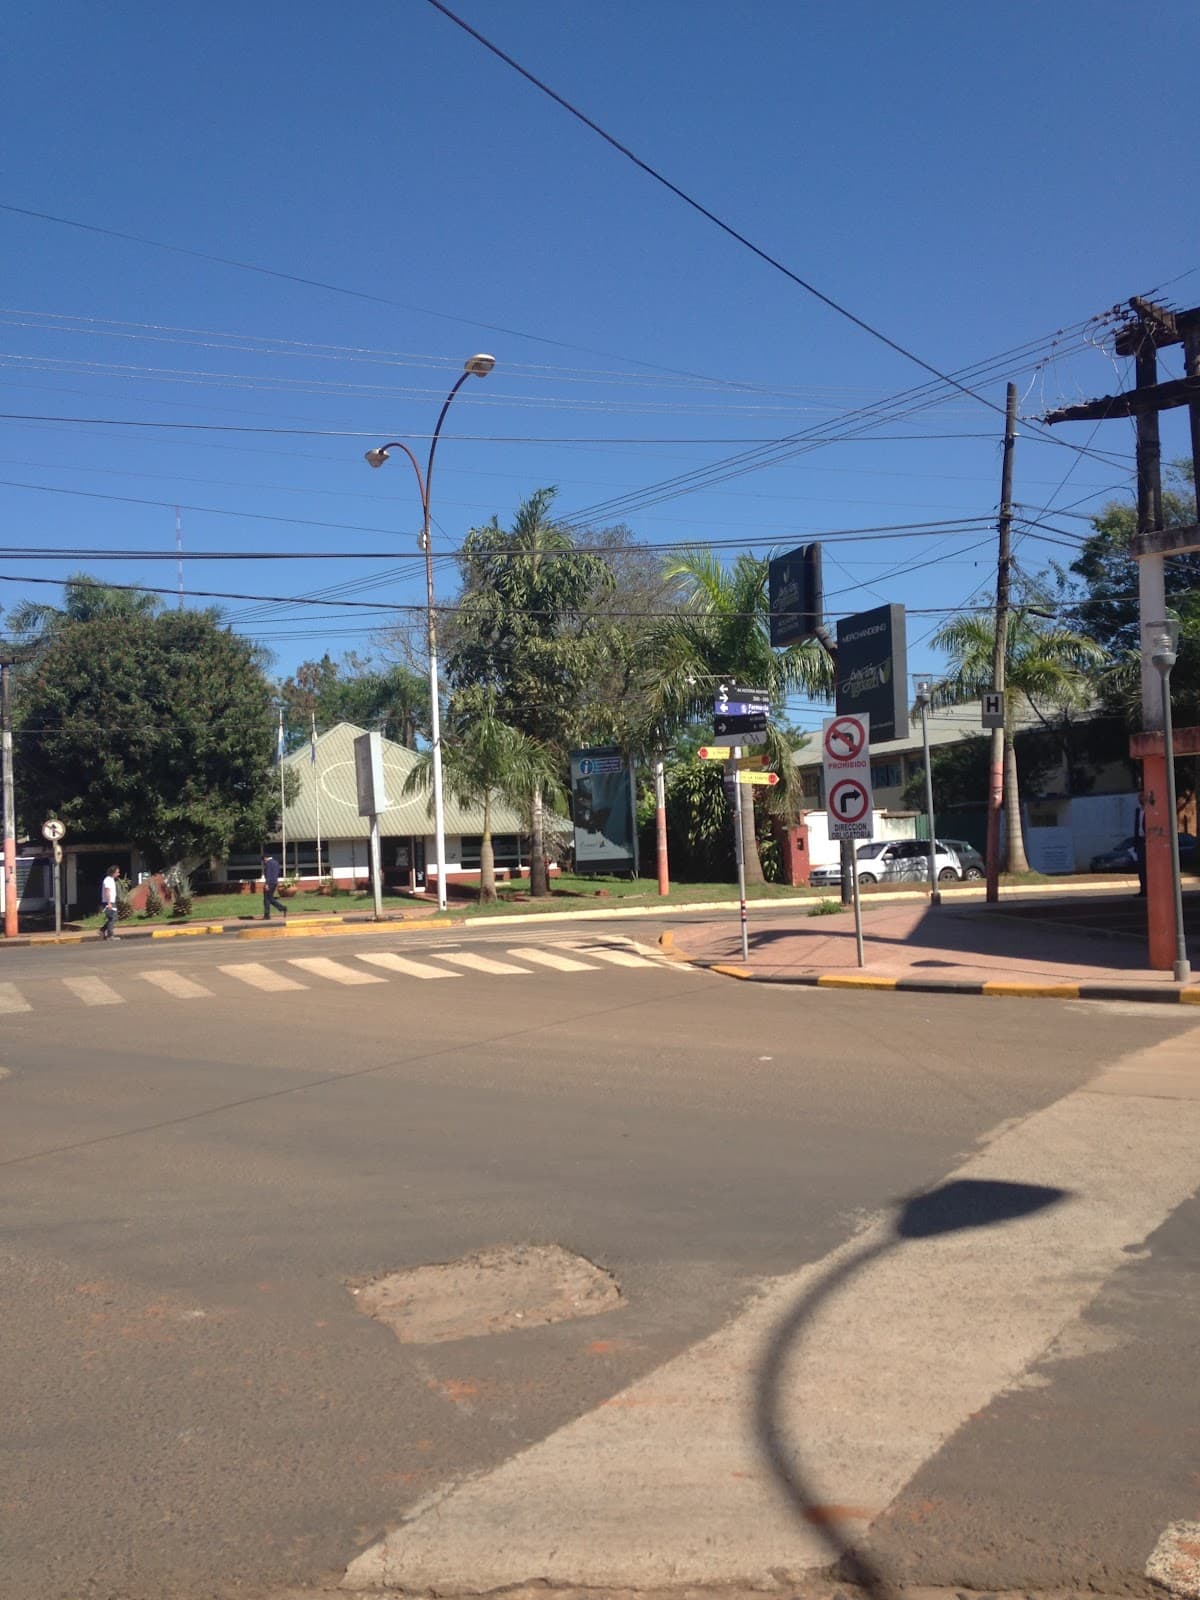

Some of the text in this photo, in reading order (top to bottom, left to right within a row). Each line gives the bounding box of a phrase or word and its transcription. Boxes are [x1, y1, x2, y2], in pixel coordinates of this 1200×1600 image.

[986, 696, 999, 713] H
[828, 761, 867, 769] PROHIBIDO
[834, 823, 867, 832] DIRECCION
[832, 831, 871, 840] OBLIGATORIA
